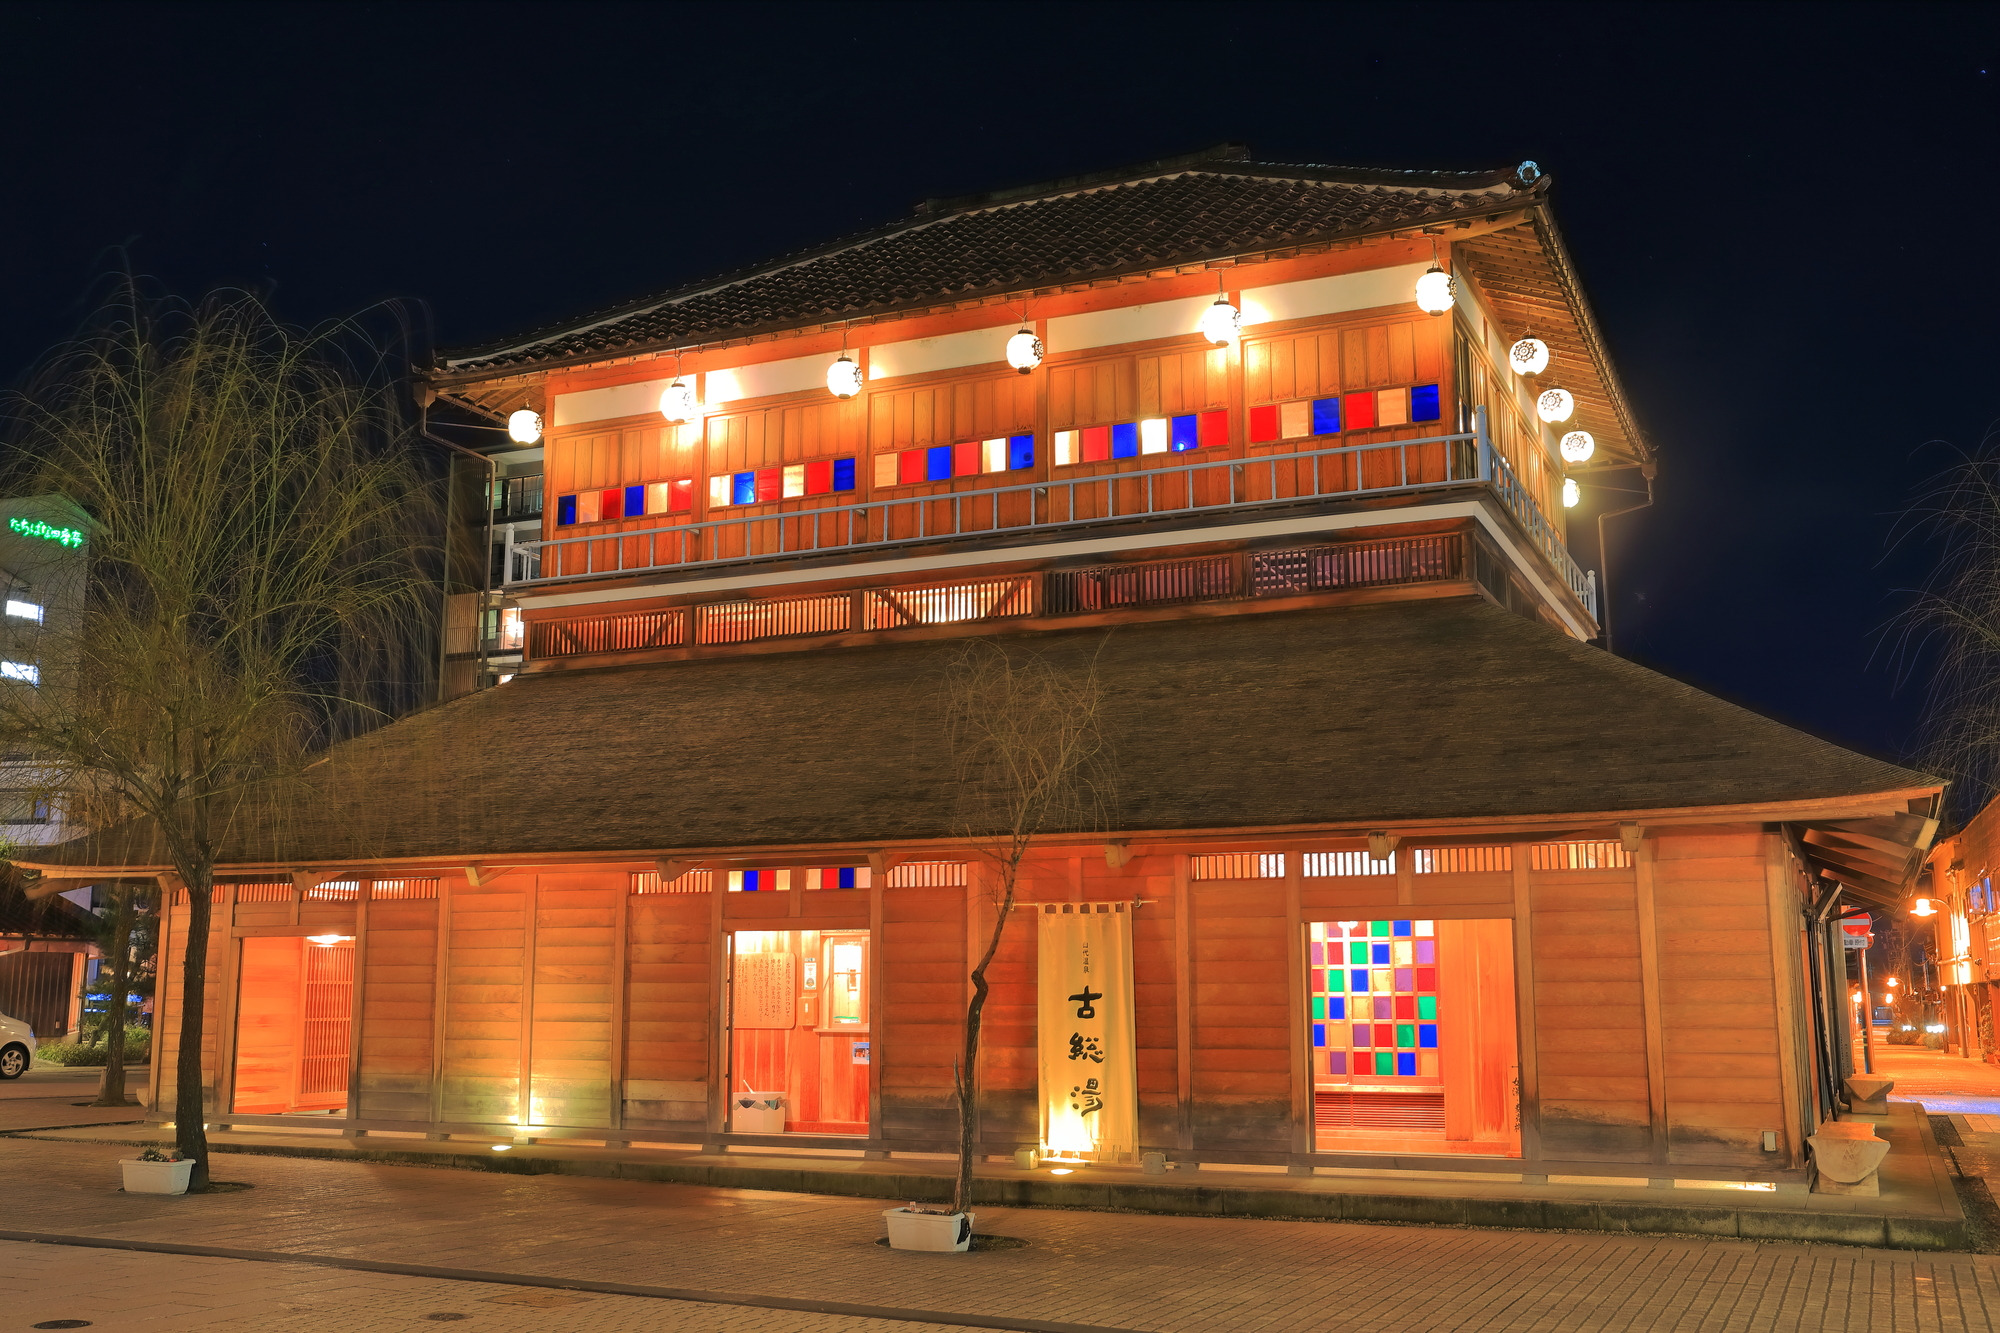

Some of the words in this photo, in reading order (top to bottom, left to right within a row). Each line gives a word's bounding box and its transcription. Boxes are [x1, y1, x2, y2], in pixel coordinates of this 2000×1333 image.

[9, 518, 83, 548] たちばな四季亭
[1082, 942, 1090, 974] 山代温泉
[1068, 985, 1106, 1118] 古総湯
